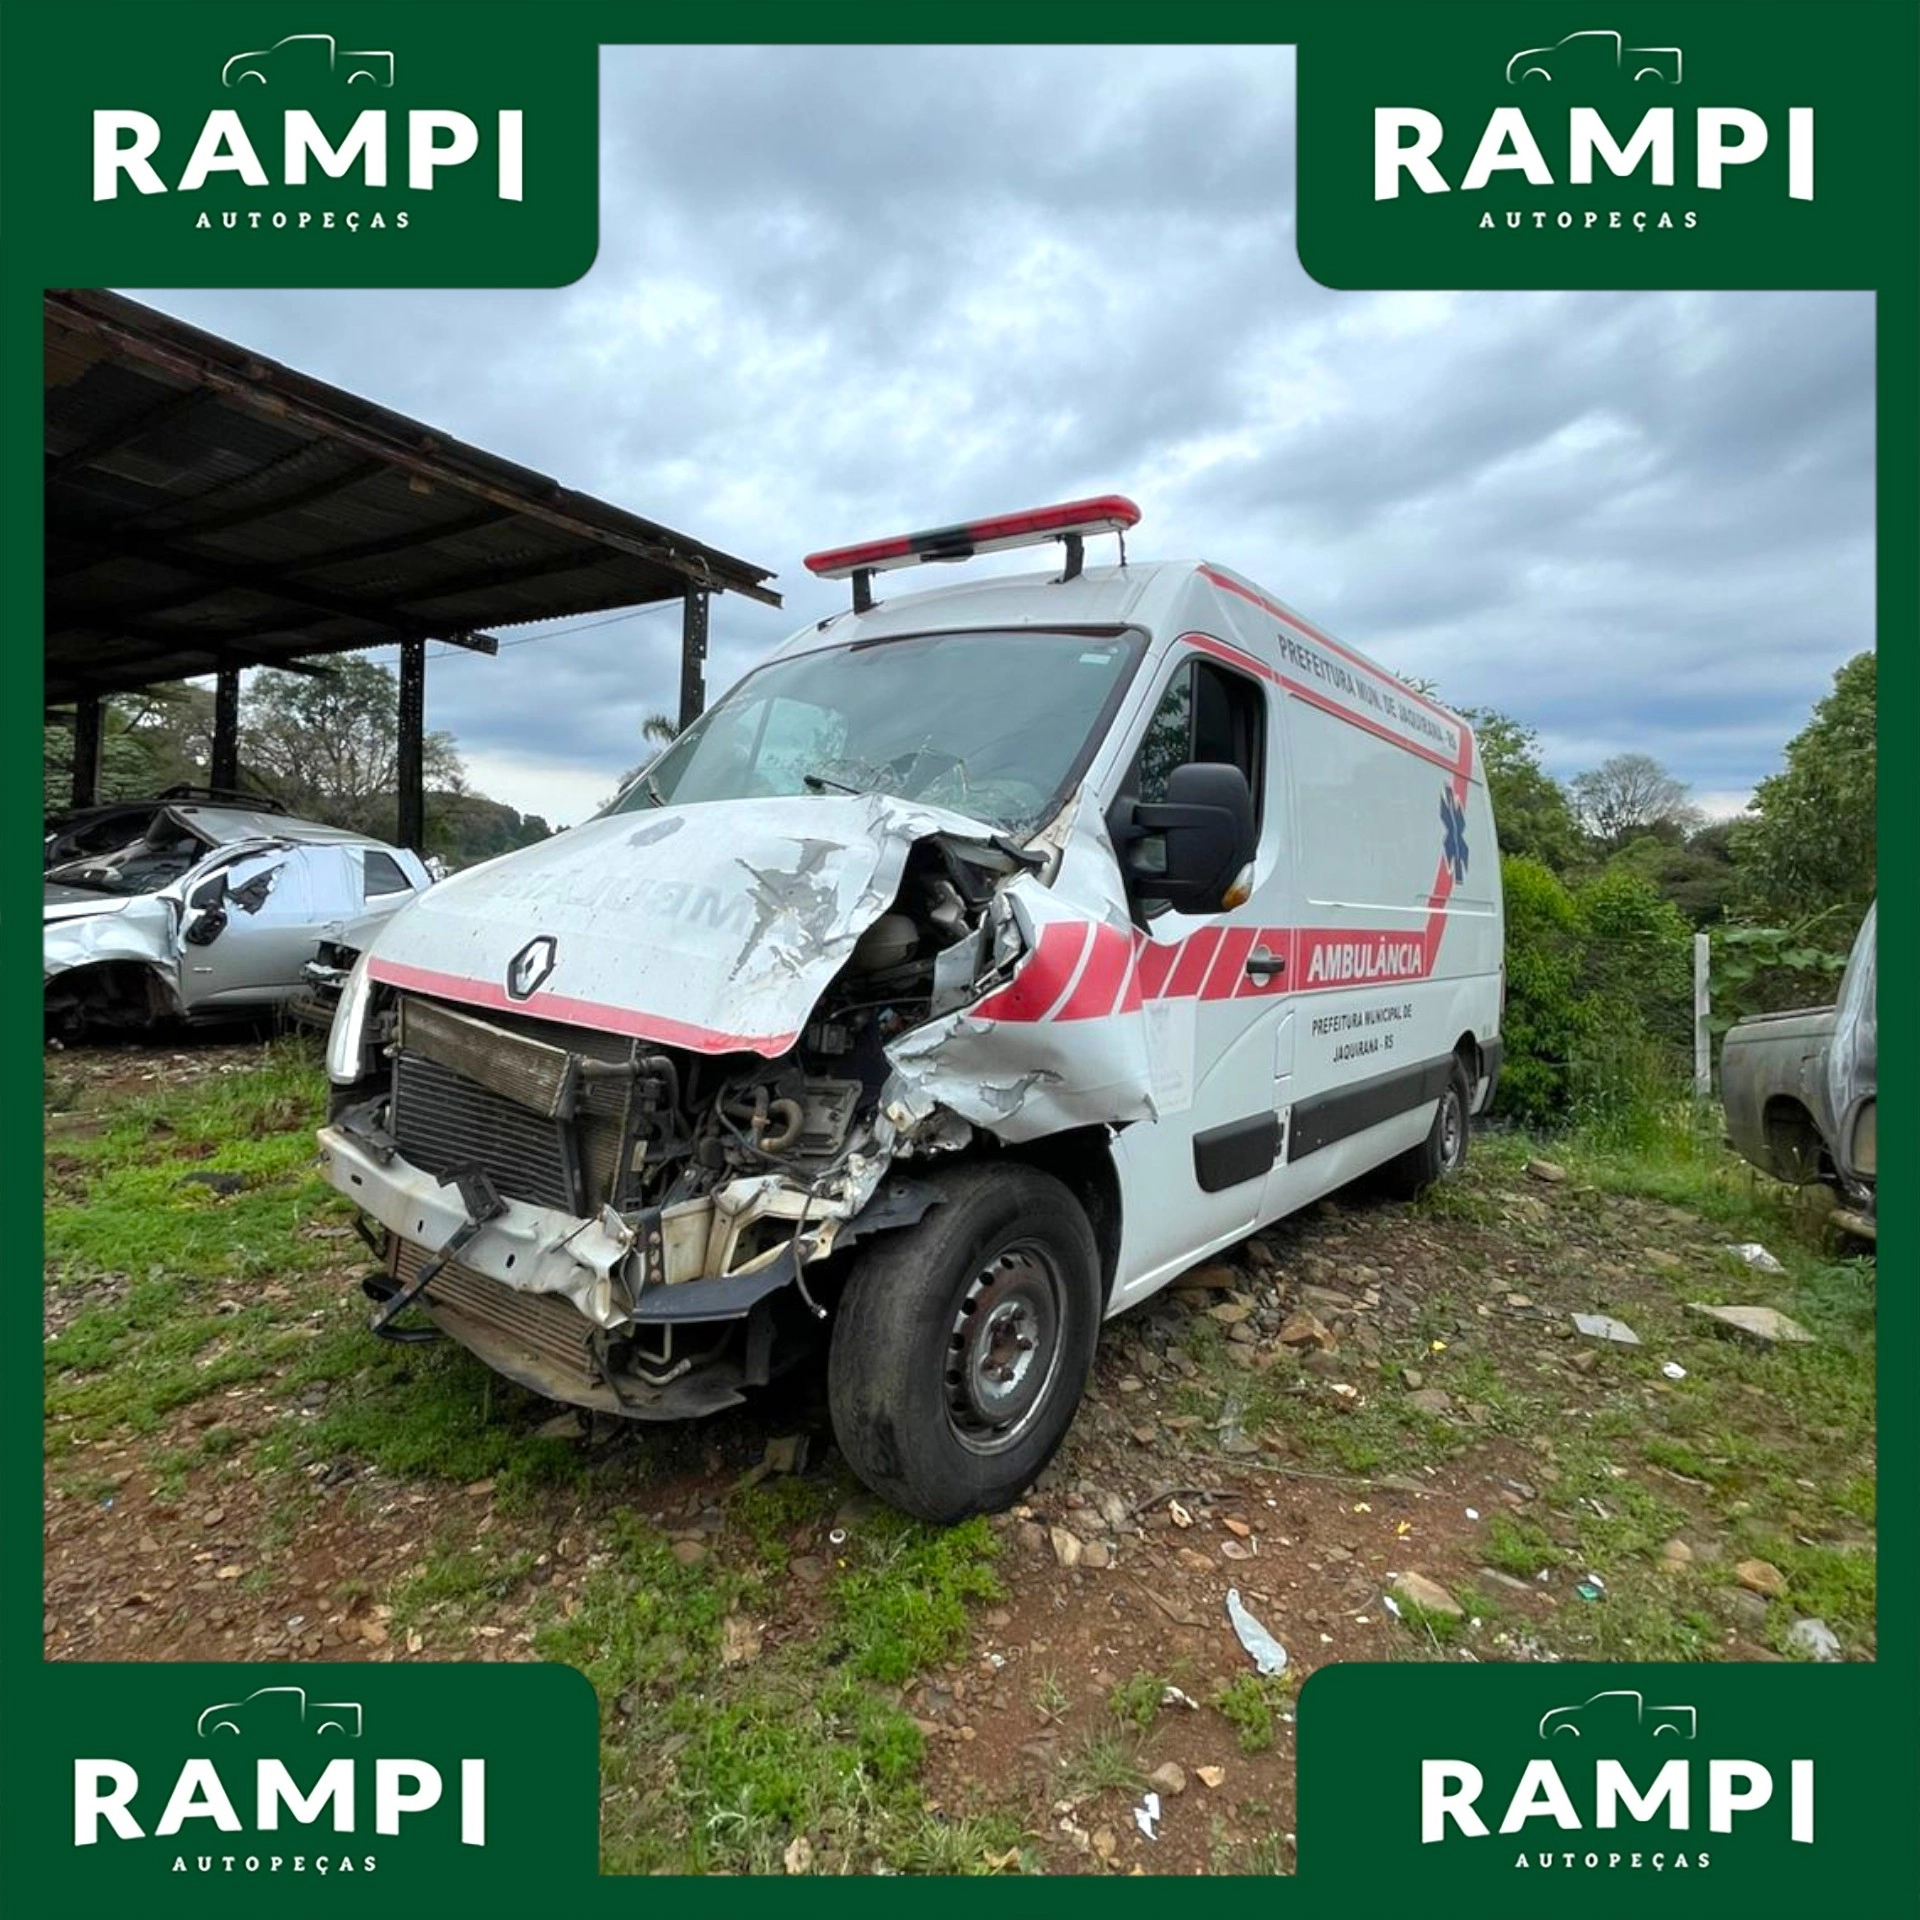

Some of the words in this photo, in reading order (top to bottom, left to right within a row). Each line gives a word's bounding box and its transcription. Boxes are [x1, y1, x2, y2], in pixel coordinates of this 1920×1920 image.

[1277, 633, 1357, 698] PREFEITURA
[1381, 693, 1397, 719] DE
[1307, 935, 1422, 983] AMBULÂNCIA
[1311, 1011, 1363, 1036] PREFEITURA
[1403, 1003, 1412, 1018] DE
[1333, 1037, 1379, 1062] JAQUIRANA
[1384, 1034, 1394, 1050] RS
